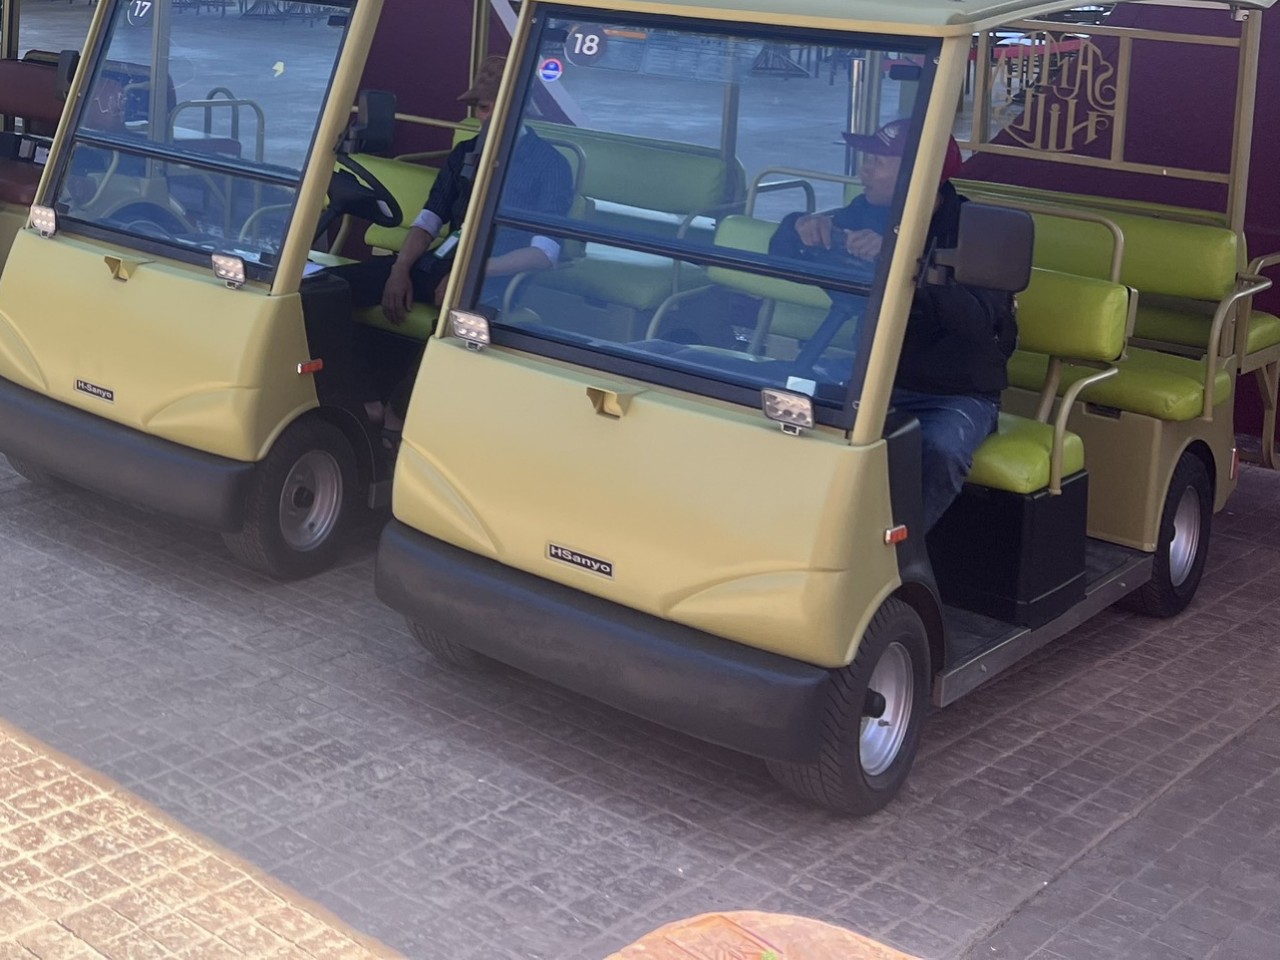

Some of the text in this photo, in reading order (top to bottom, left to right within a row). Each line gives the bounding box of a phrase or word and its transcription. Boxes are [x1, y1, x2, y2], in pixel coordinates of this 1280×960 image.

[133, 0, 152, 18] 17
[573, 32, 600, 56] 18
[77, 380, 113, 399] H-Sanyo
[550, 545, 611, 572] HSanyo
